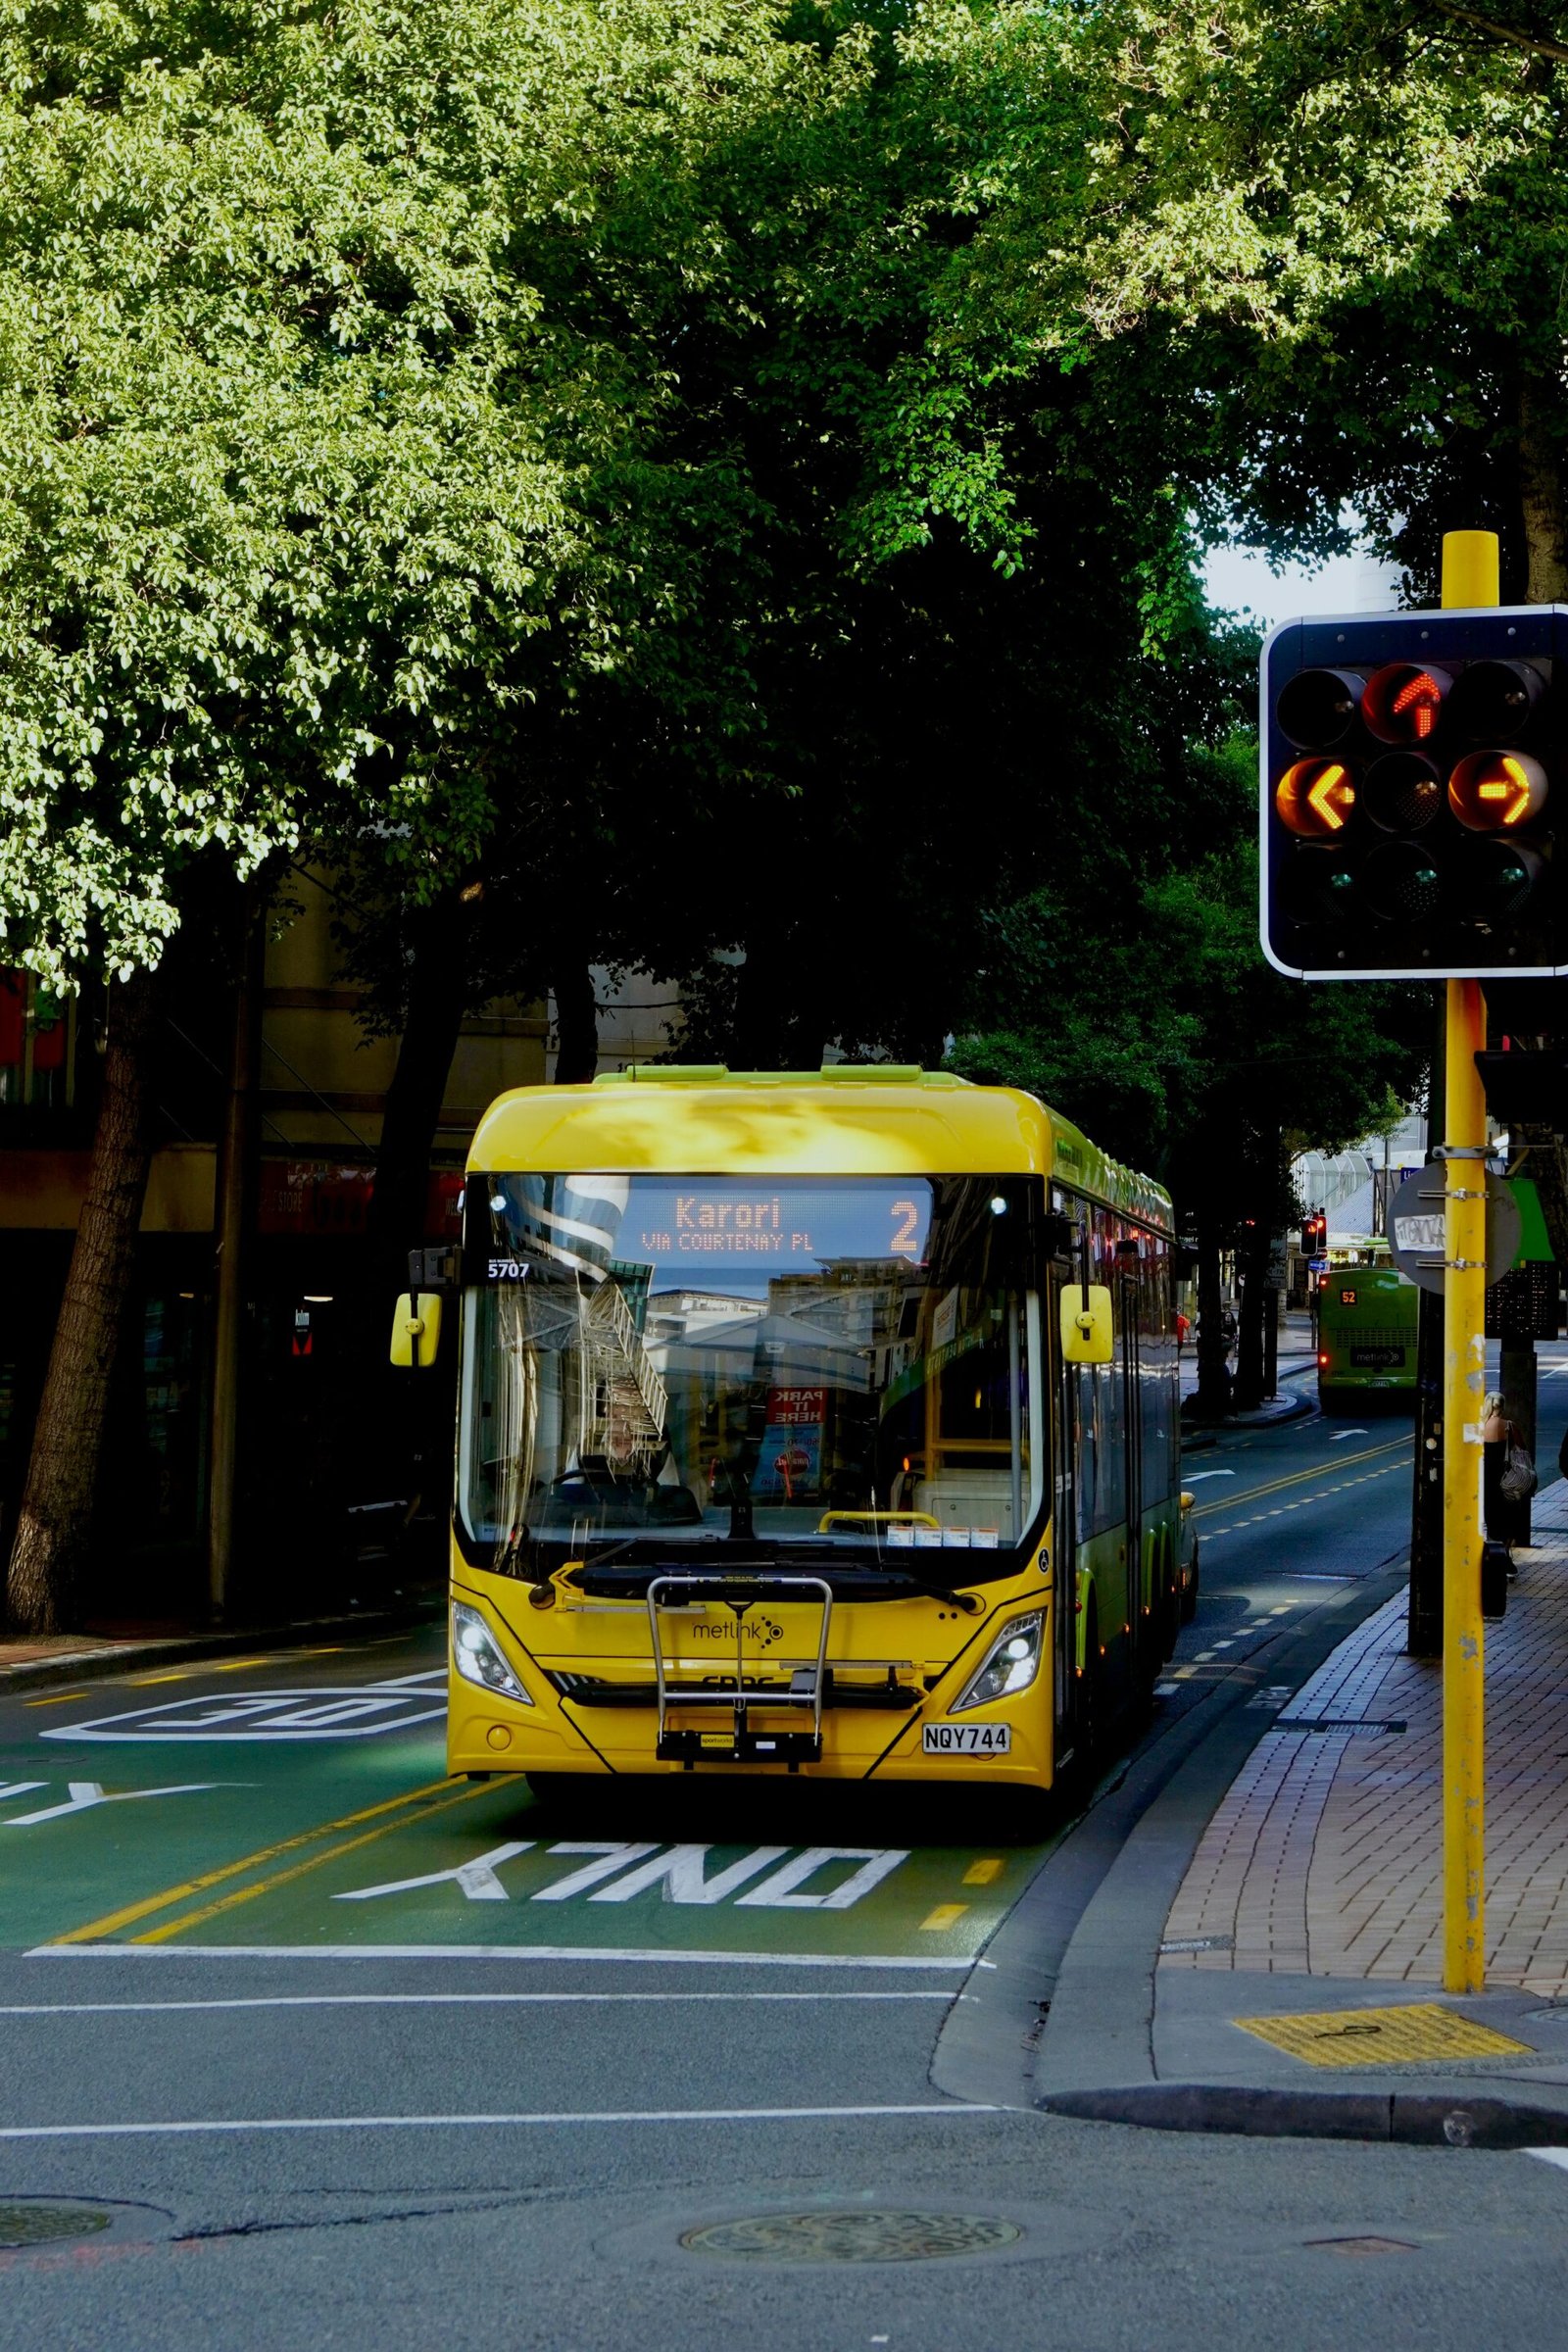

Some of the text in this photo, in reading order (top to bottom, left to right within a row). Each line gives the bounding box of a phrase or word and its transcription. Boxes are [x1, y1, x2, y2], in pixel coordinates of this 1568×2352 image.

[676, 1198, 780, 1228] Karori
[890, 1201, 918, 1251] 2
[642, 1233, 813, 1250] VIA COURTENAY PL
[488, 1263, 529, 1278] 5707
[1342, 1292, 1355, 1303] 52
[1356, 1353, 1389, 1362] metlink
[692, 1621, 761, 1640] metlink
[925, 1728, 1006, 1749] NQY744
[329, 1841, 911, 1909] ONLY
